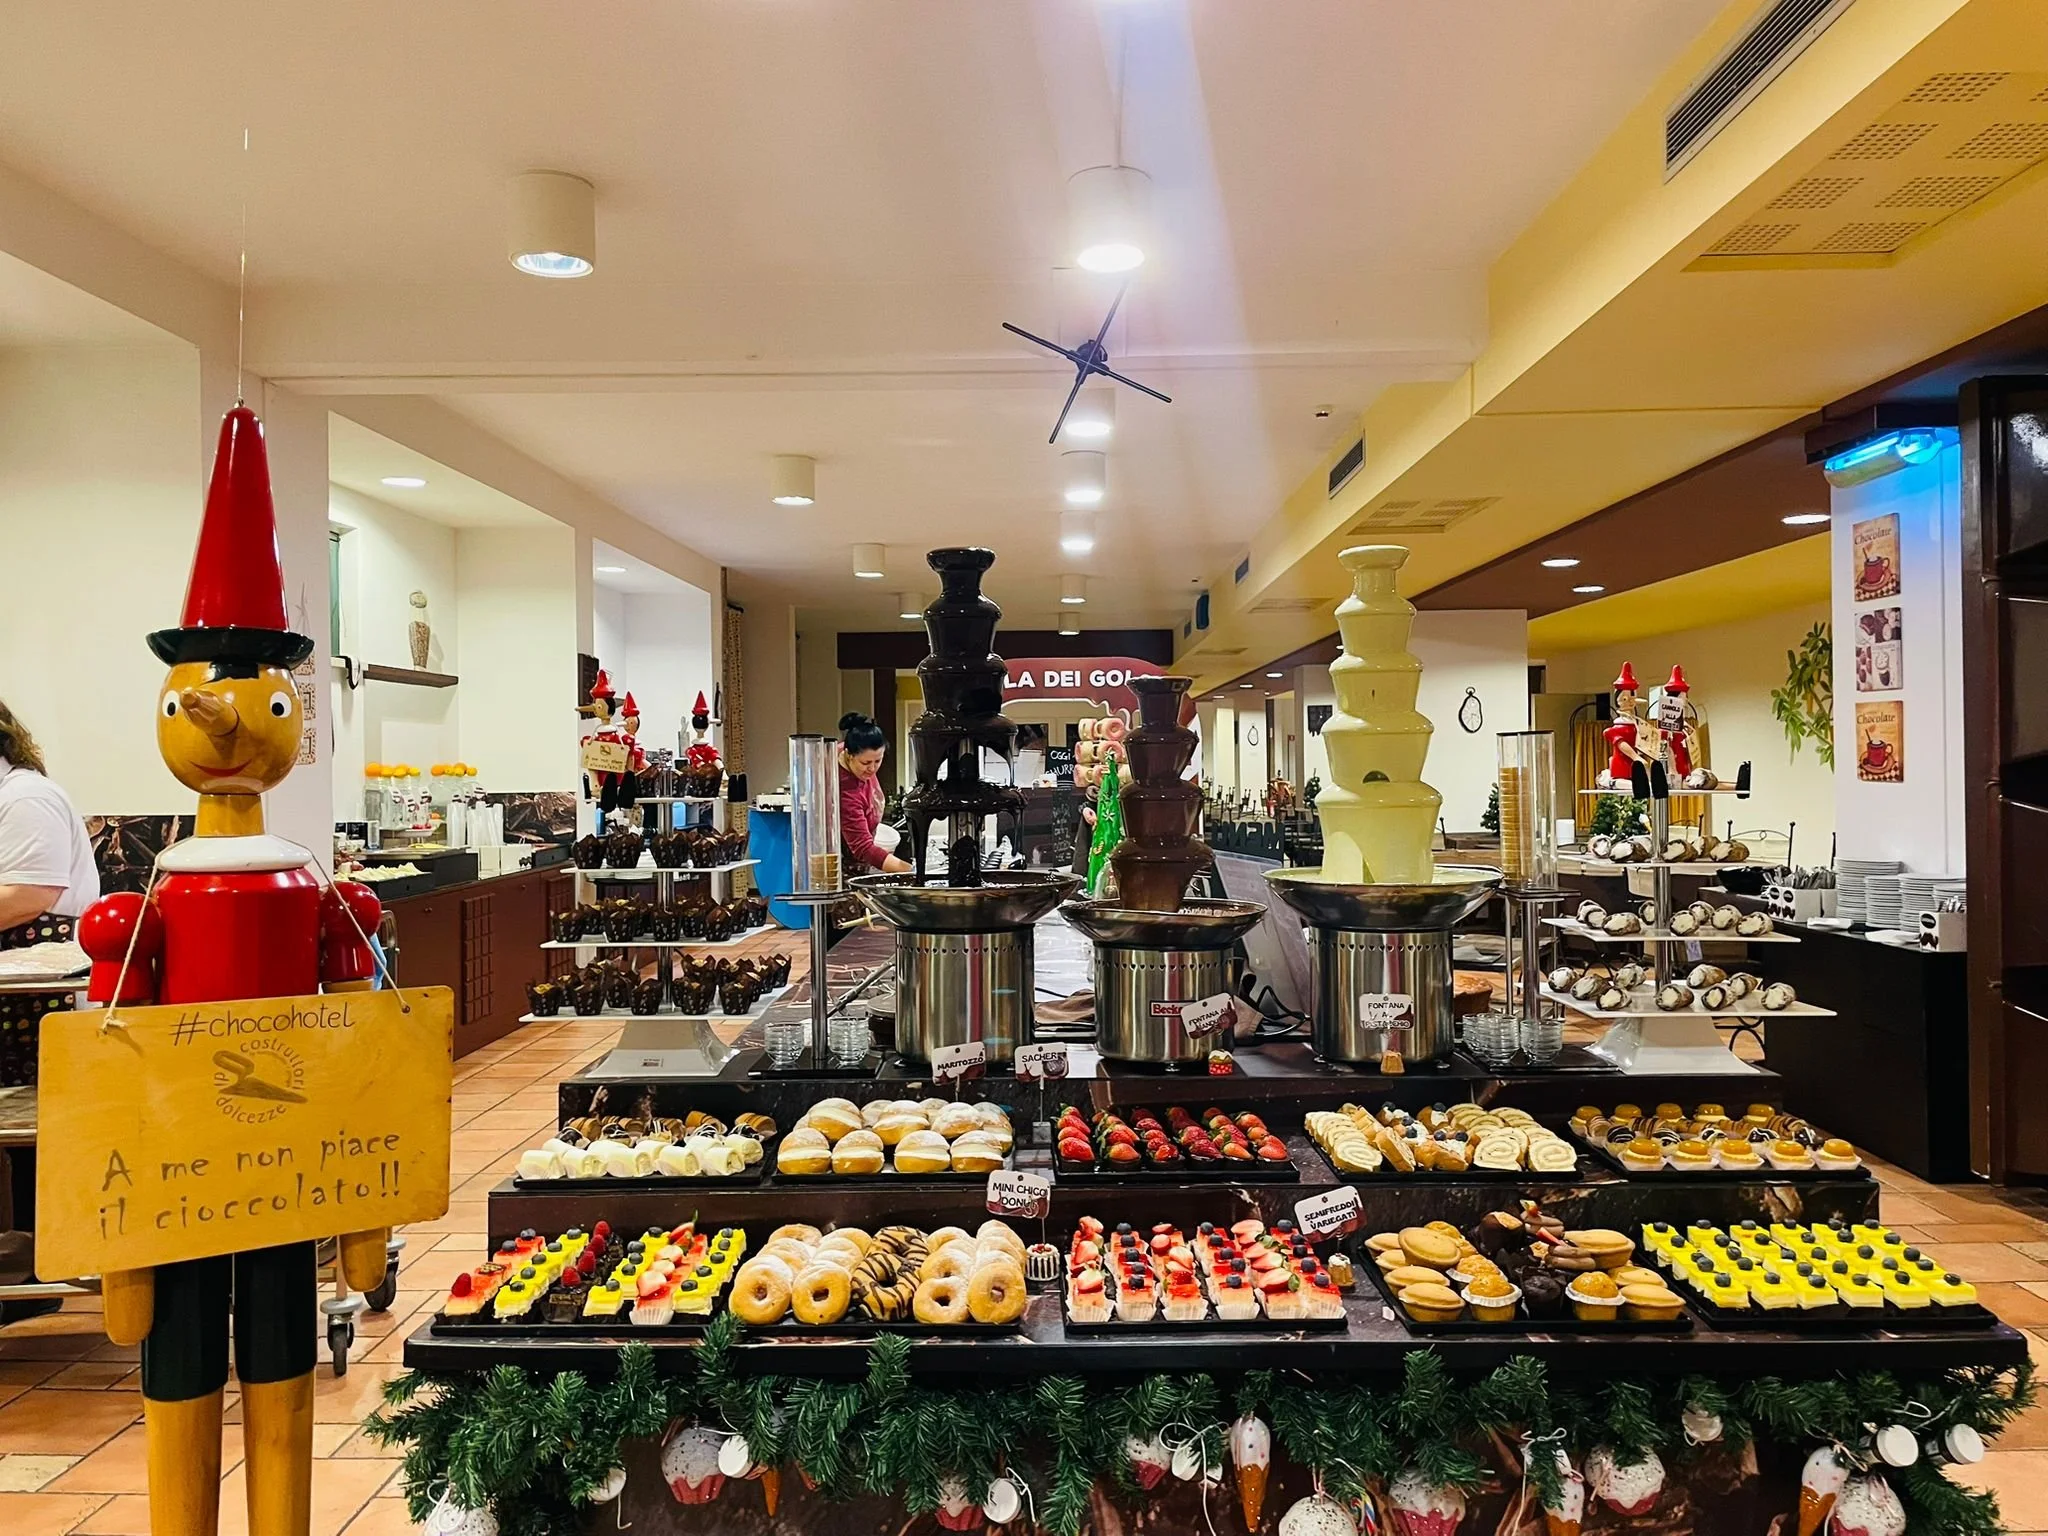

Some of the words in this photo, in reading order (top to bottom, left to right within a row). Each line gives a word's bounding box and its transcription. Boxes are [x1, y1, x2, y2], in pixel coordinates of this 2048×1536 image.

[1044, 670, 1081, 687] DEI
[1856, 711, 1896, 724] Chocolate
[168, 1002, 356, 1046] #chocohotel
[1188, 1009, 1220, 1026] FONTANA
[239, 1038, 305, 1091] costruttori
[1021, 1051, 1058, 1063] SACHER
[215, 1096, 287, 1124] dolcezze
[102, 1149, 133, 1192] A
[161, 1158, 211, 1182] me
[236, 1146, 294, 1173] non
[320, 1130, 401, 1172] piace
[992, 1182, 1014, 1193] MINI
[99, 1197, 126, 1240] il
[155, 1161, 401, 1231] cioccolato!!
[1304, 1200, 1355, 1222] SEMIFREDDI
[1309, 1211, 1356, 1230] VARIEGATI
